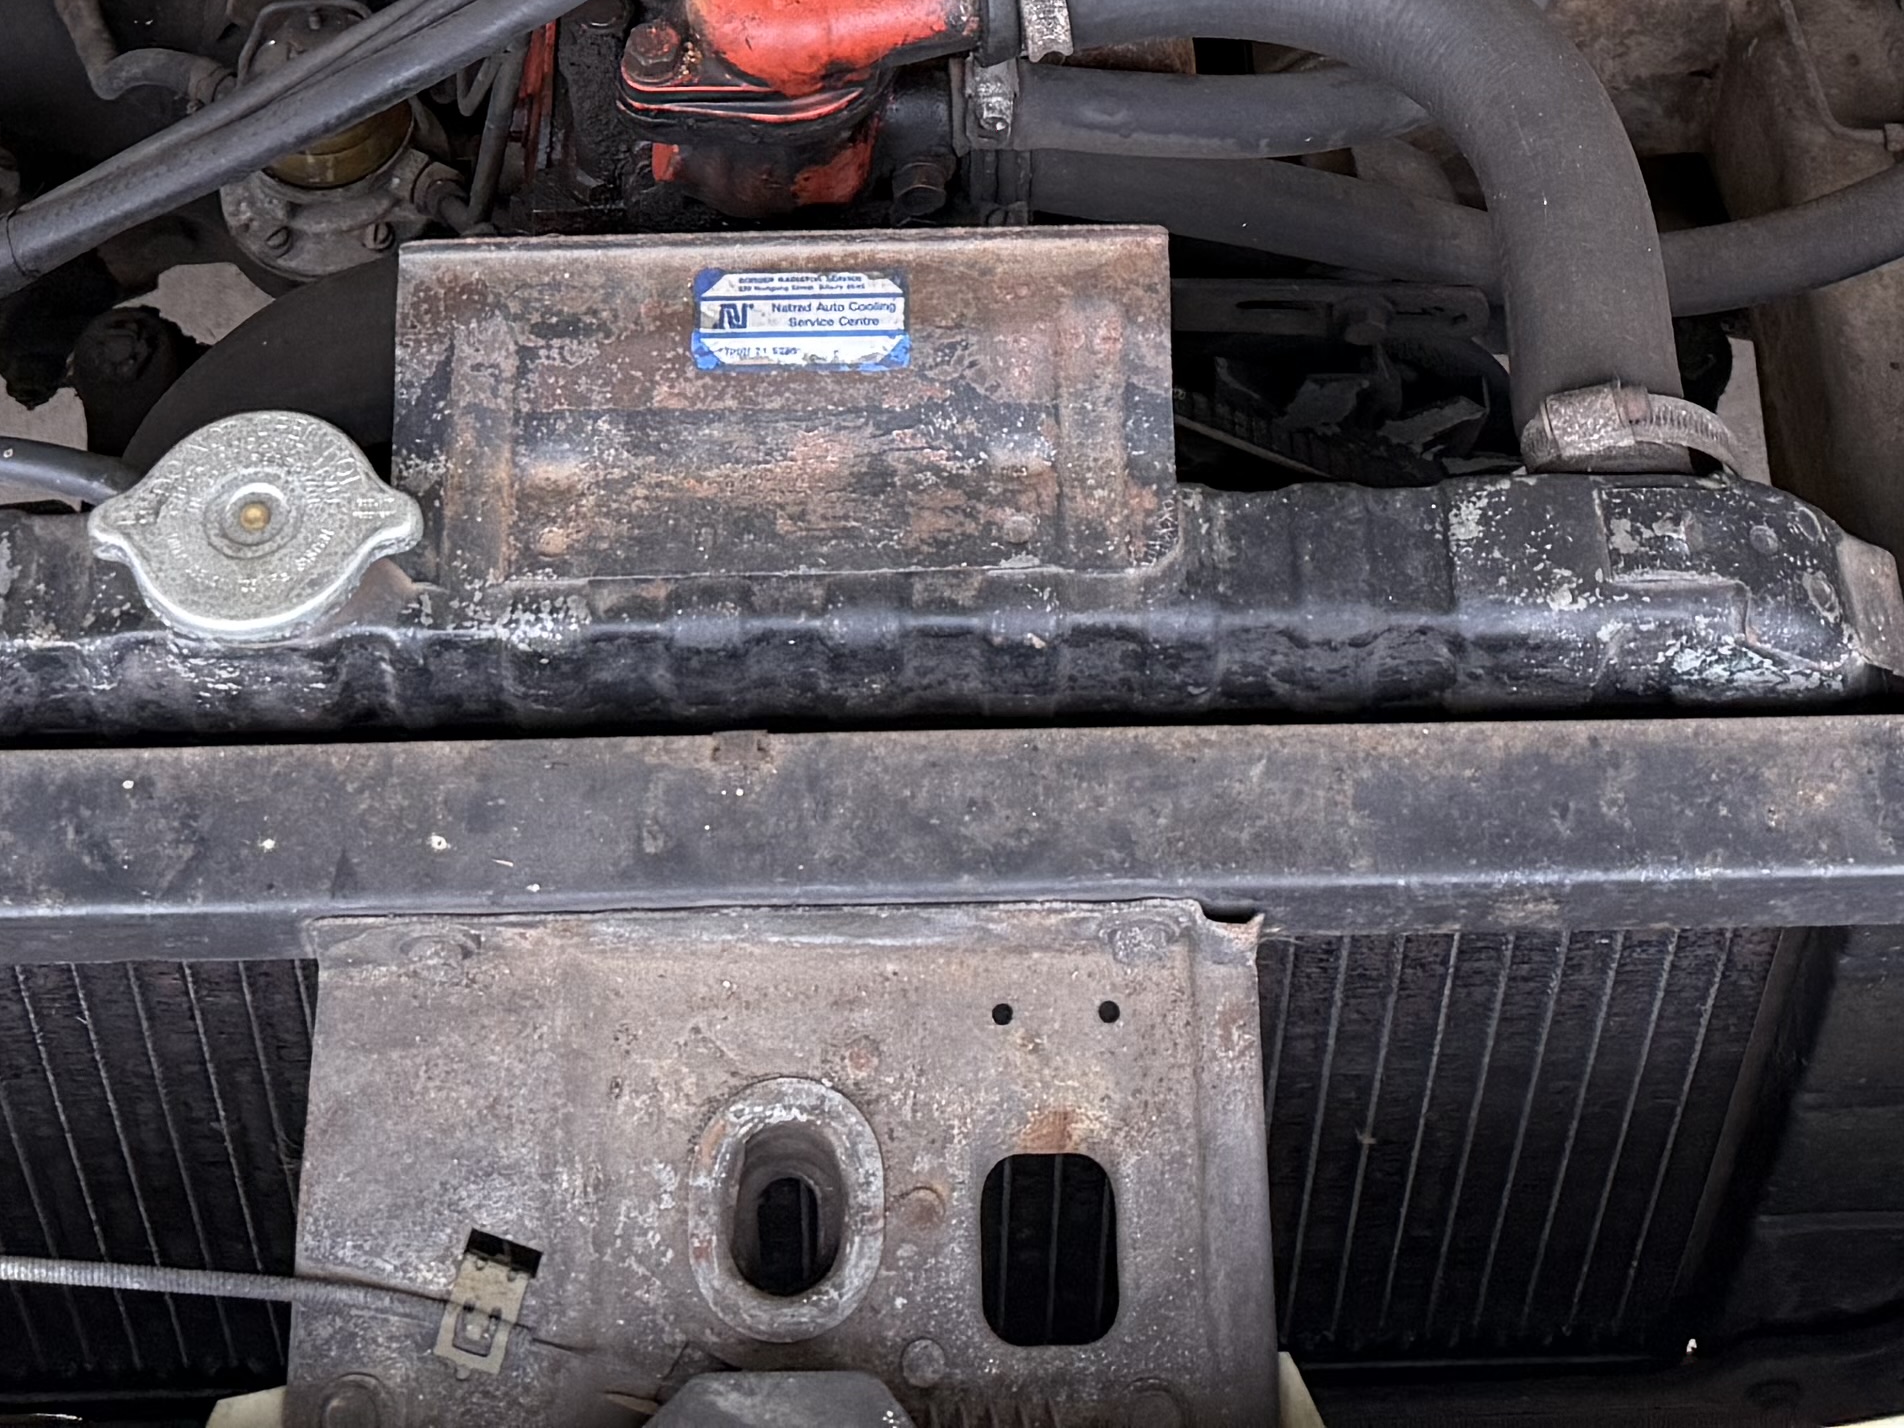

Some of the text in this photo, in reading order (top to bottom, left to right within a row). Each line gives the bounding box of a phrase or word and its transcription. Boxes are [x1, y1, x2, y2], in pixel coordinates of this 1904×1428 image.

[816, 302, 845, 313] Auto
[849, 301, 897, 314] Cooling
[788, 316, 880, 328] Service Centre
